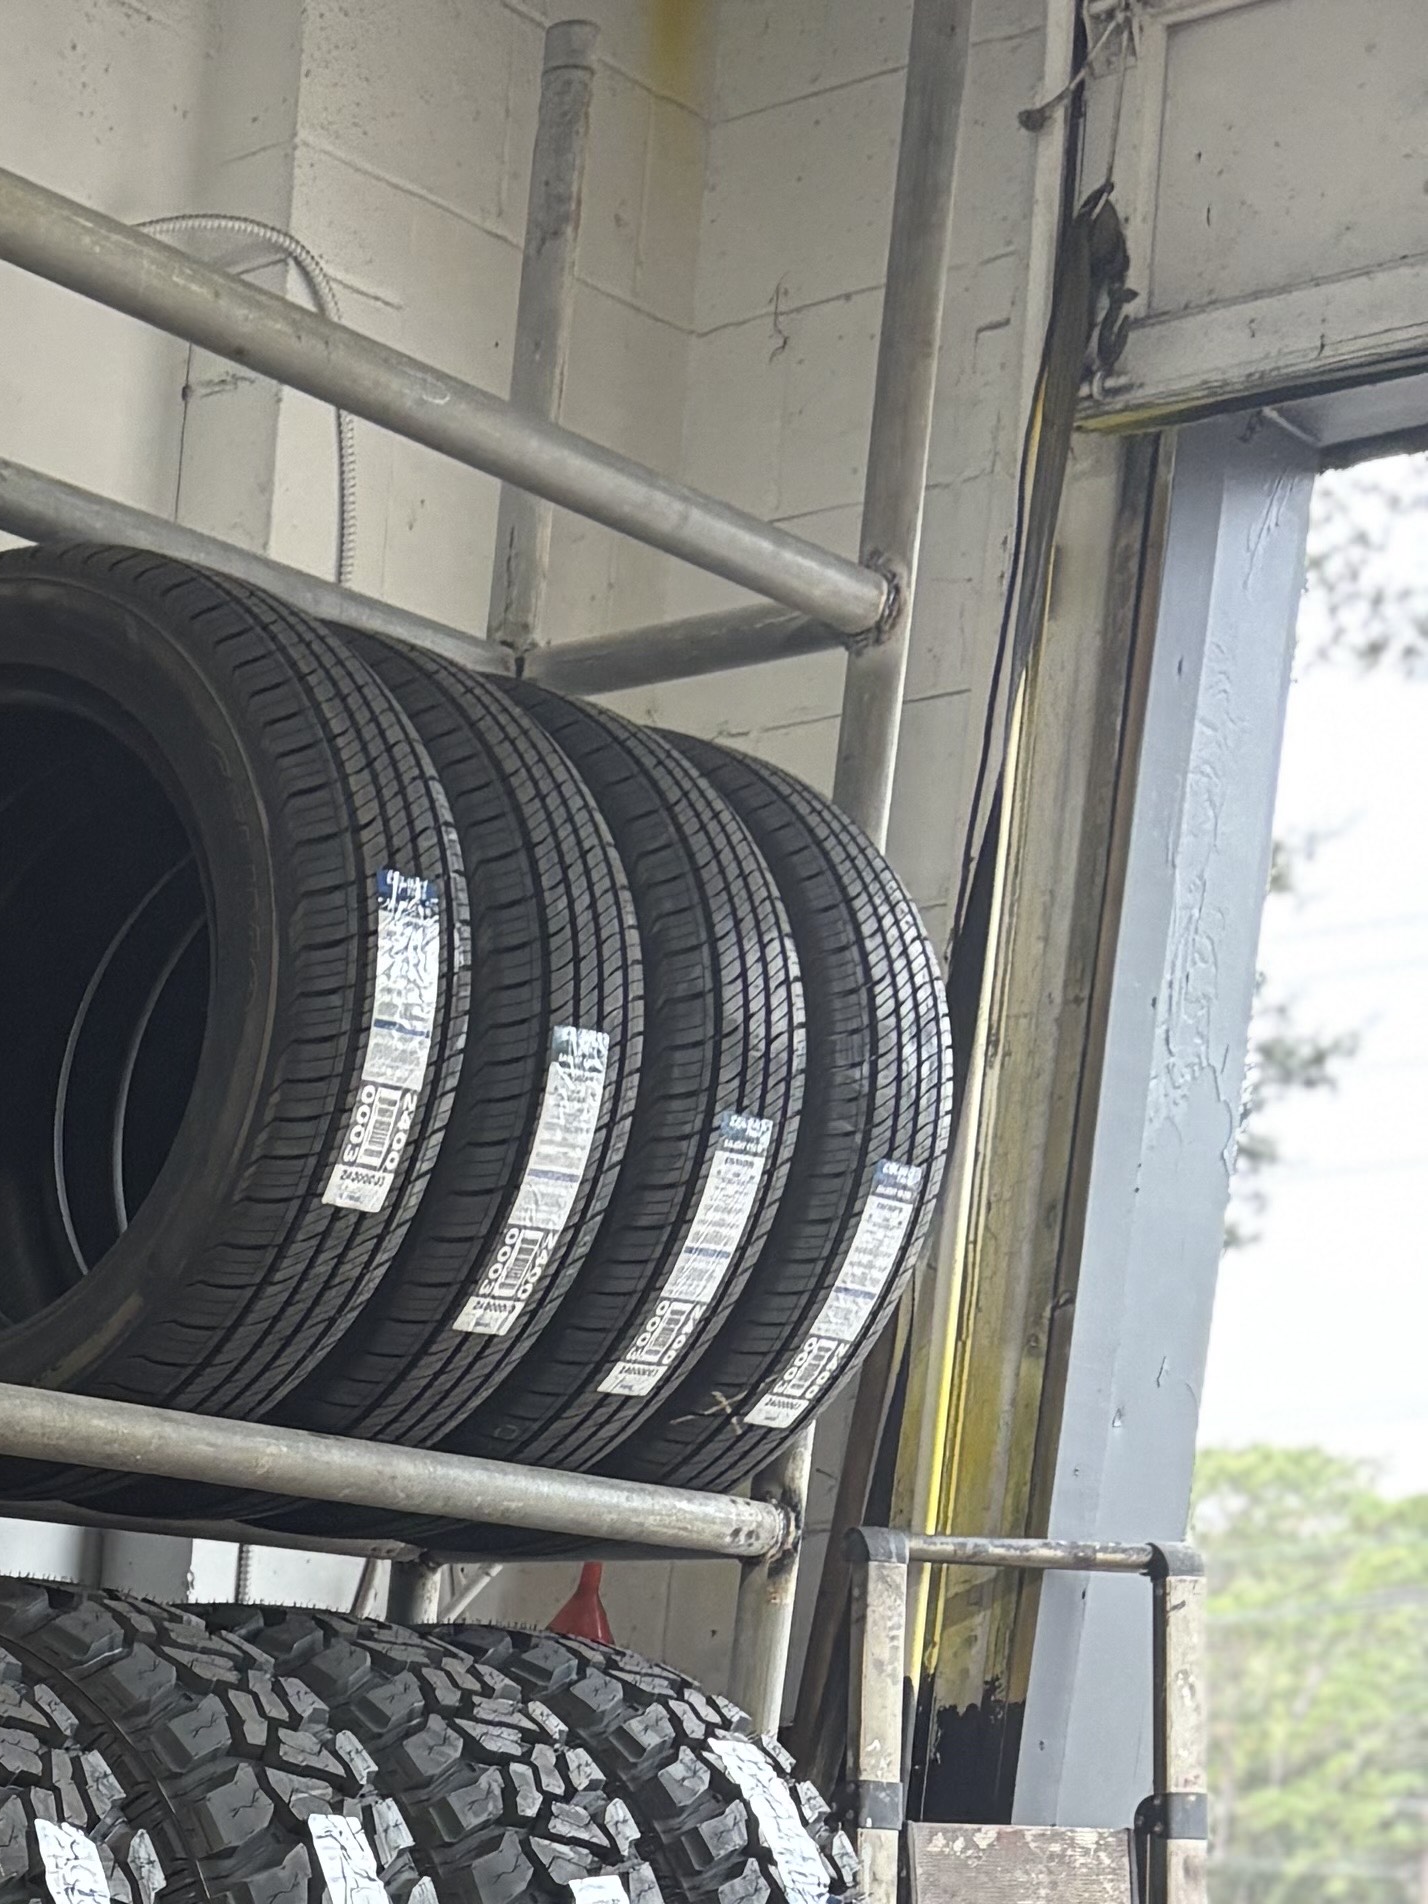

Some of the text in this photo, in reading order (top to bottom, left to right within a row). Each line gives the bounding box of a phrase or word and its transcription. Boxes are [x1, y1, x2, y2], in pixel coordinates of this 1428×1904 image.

[341, 1084, 377, 1164] 0003
[382, 1090, 417, 1172] 2400
[478, 1227, 521, 1295] 0003
[626, 1300, 671, 1362] 0003
[773, 1336, 817, 1397] 0003
